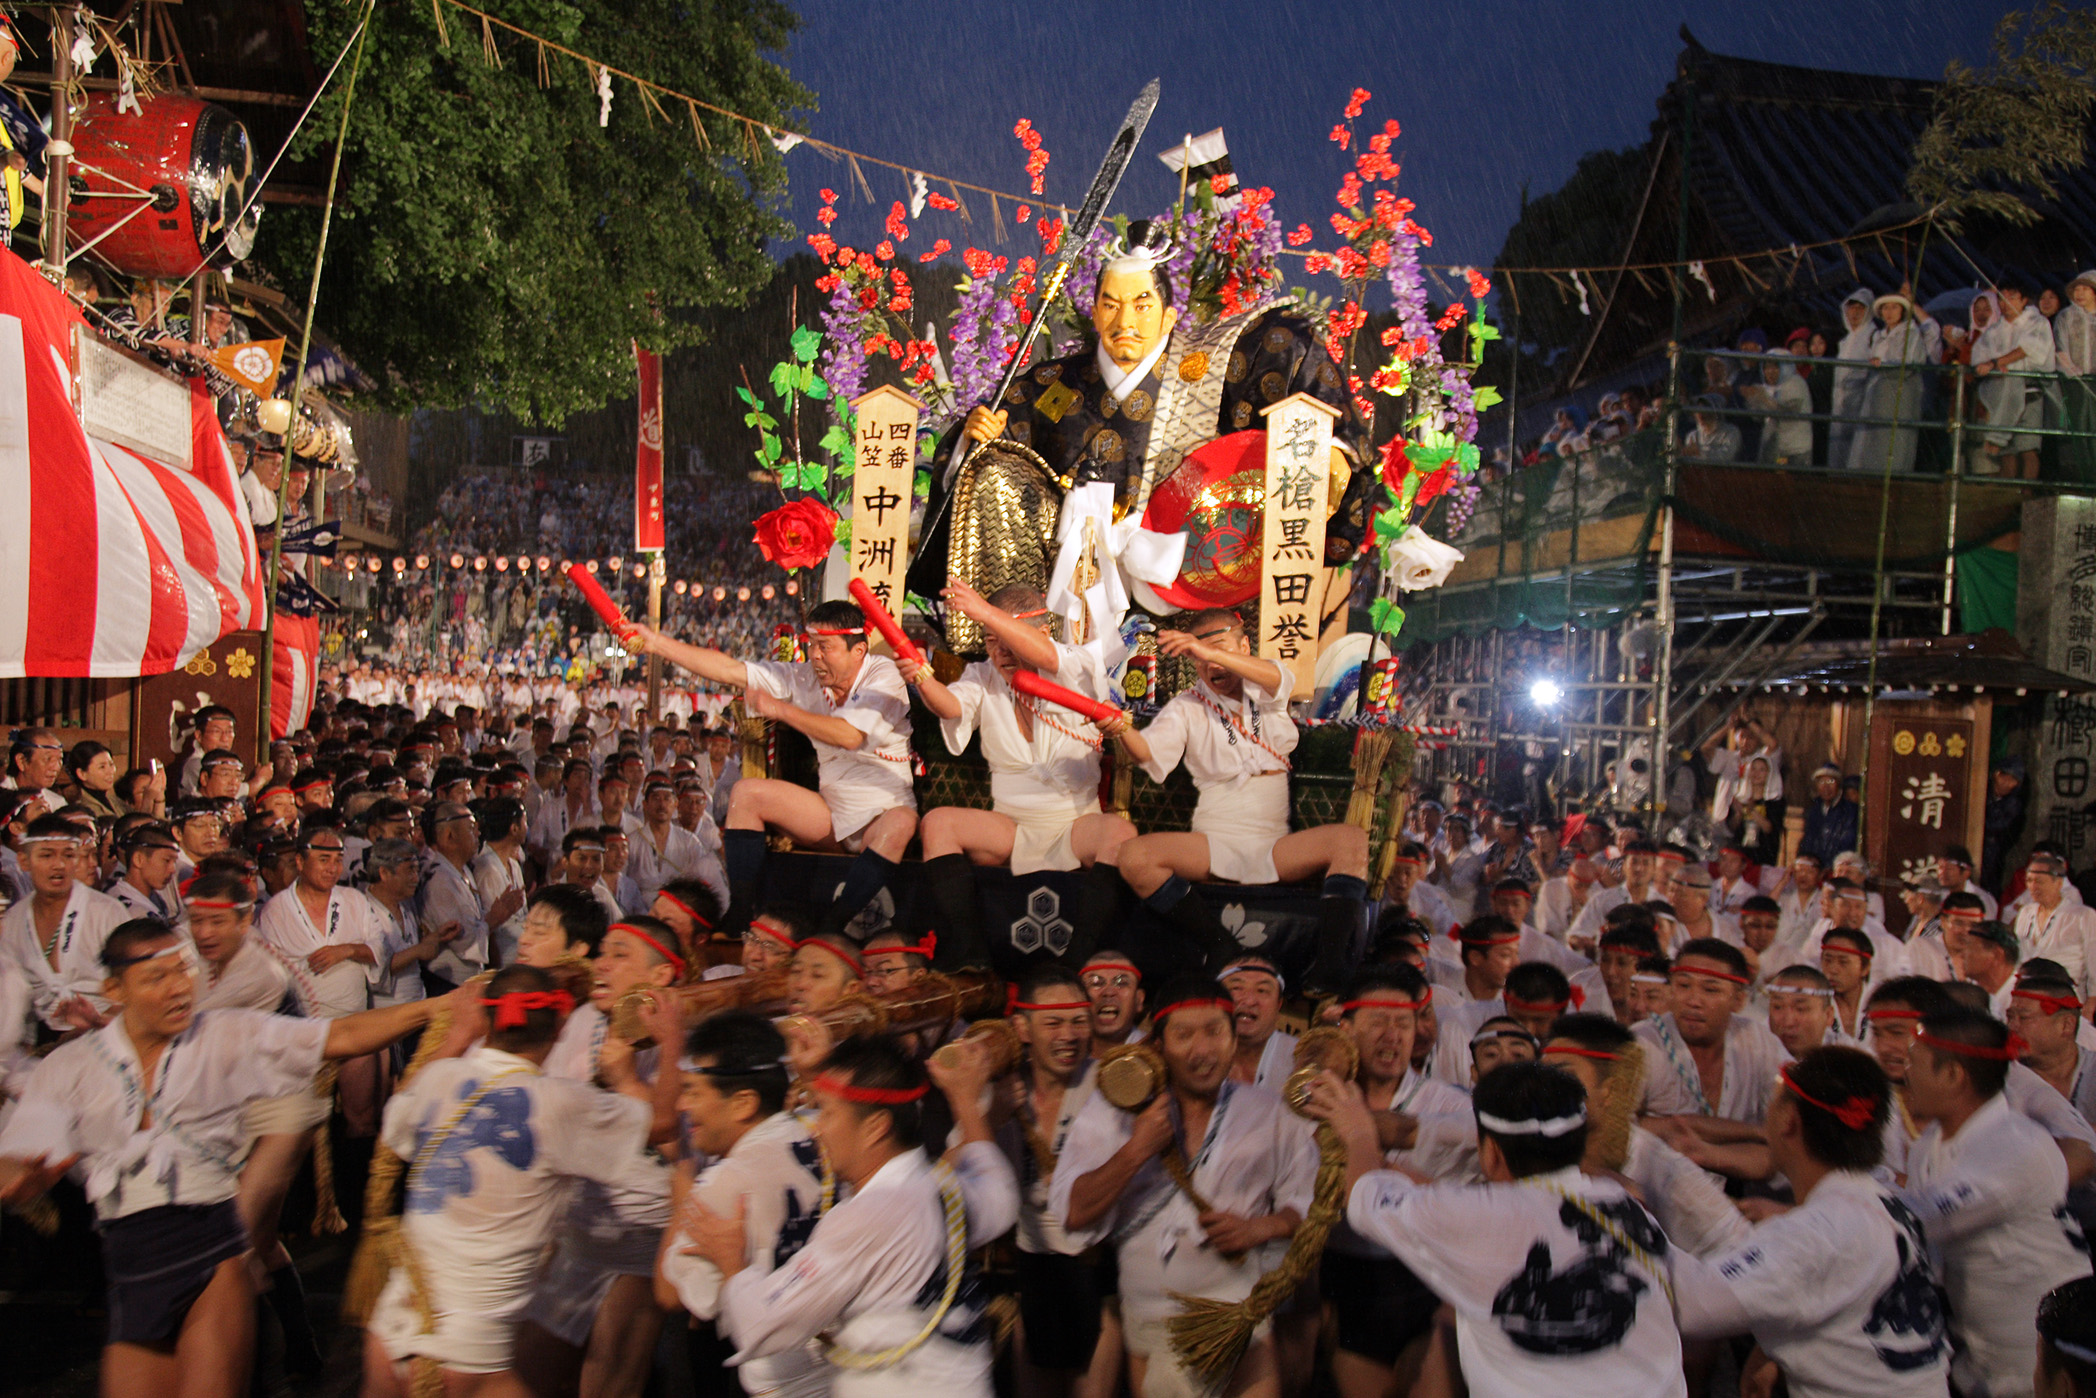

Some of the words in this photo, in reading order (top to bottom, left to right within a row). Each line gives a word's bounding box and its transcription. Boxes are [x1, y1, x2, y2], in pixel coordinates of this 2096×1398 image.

[861, 420, 884, 467] 山笠
[886, 422, 912, 469] 四番
[1266, 417, 1323, 661] 名槍黒田誉
